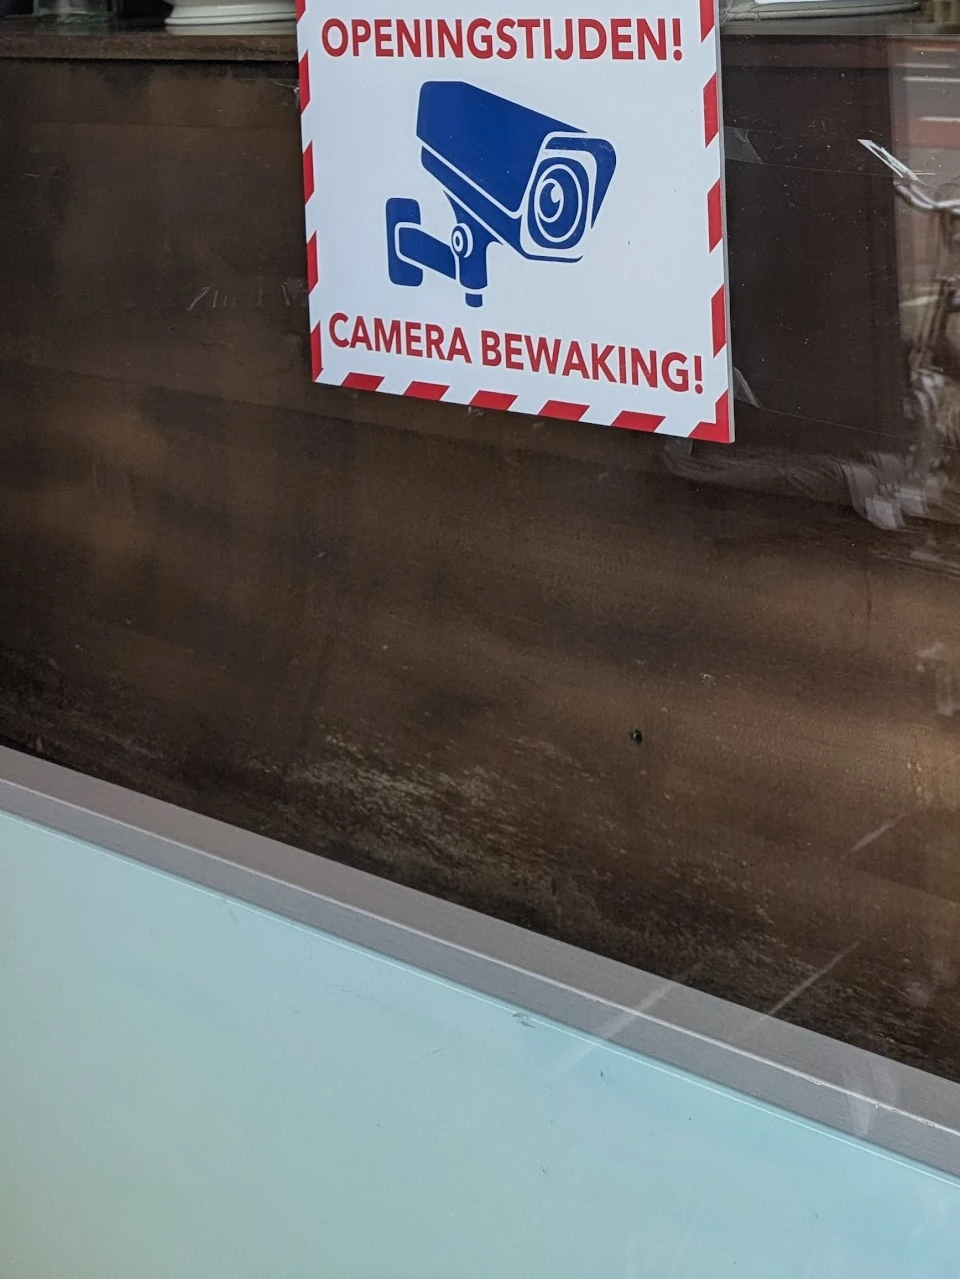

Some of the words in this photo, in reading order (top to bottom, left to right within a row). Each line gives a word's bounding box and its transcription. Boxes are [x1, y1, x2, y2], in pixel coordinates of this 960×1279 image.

[321, 17, 684, 61] OPENINGSTIJDEN!
[328, 312, 472, 364] CAMERA
[481, 330, 704, 395] BEWAKING!
